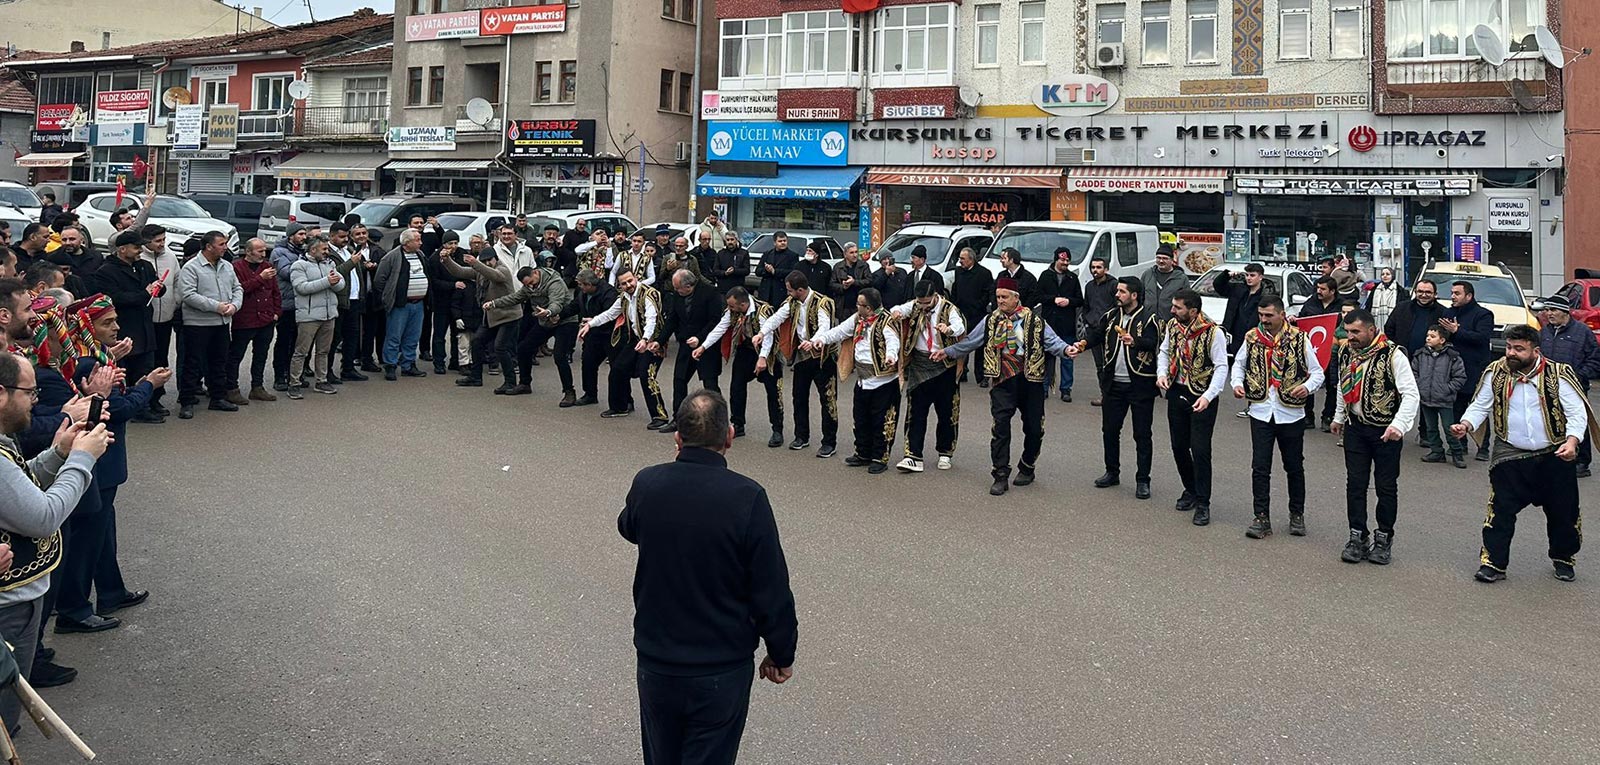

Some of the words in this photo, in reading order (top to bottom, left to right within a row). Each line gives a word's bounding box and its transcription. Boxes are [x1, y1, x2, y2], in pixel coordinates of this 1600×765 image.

[502, 13, 528, 22] VATAN
[423, 18, 446, 30] VATAN
[100, 94, 120, 102] YILDIZ
[1042, 83, 1108, 103] KTM
[1272, 96, 1312, 106] KURSU
[920, 106, 945, 116] BEY
[211, 115, 235, 126] FOTO
[408, 128, 437, 136] UZMAN
[732, 126, 770, 141] YÜCEL
[772, 128, 823, 141] MARKET
[852, 126, 991, 144] KURŞUNLU
[1016, 124, 1148, 141] TİCARET
[1176, 120, 1328, 140] MERKEZİ
[750, 146, 802, 159] MANAV
[932, 144, 996, 162] kasap
[1286, 149, 1324, 158] Telekom
[902, 176, 950, 184] CEYLAN
[968, 177, 1012, 185] KASAP
[1075, 180, 1106, 188] CADDE
[1288, 179, 1342, 189] TUĞRA
[1346, 179, 1413, 189] TİCARET
[712, 186, 742, 195] YÜCEL
[749, 188, 786, 196] MARKET
[794, 188, 828, 197] MANAV
[960, 202, 1008, 212] CEYLAN
[963, 213, 1005, 223] KASAP
[861, 206, 870, 248] MARKET
